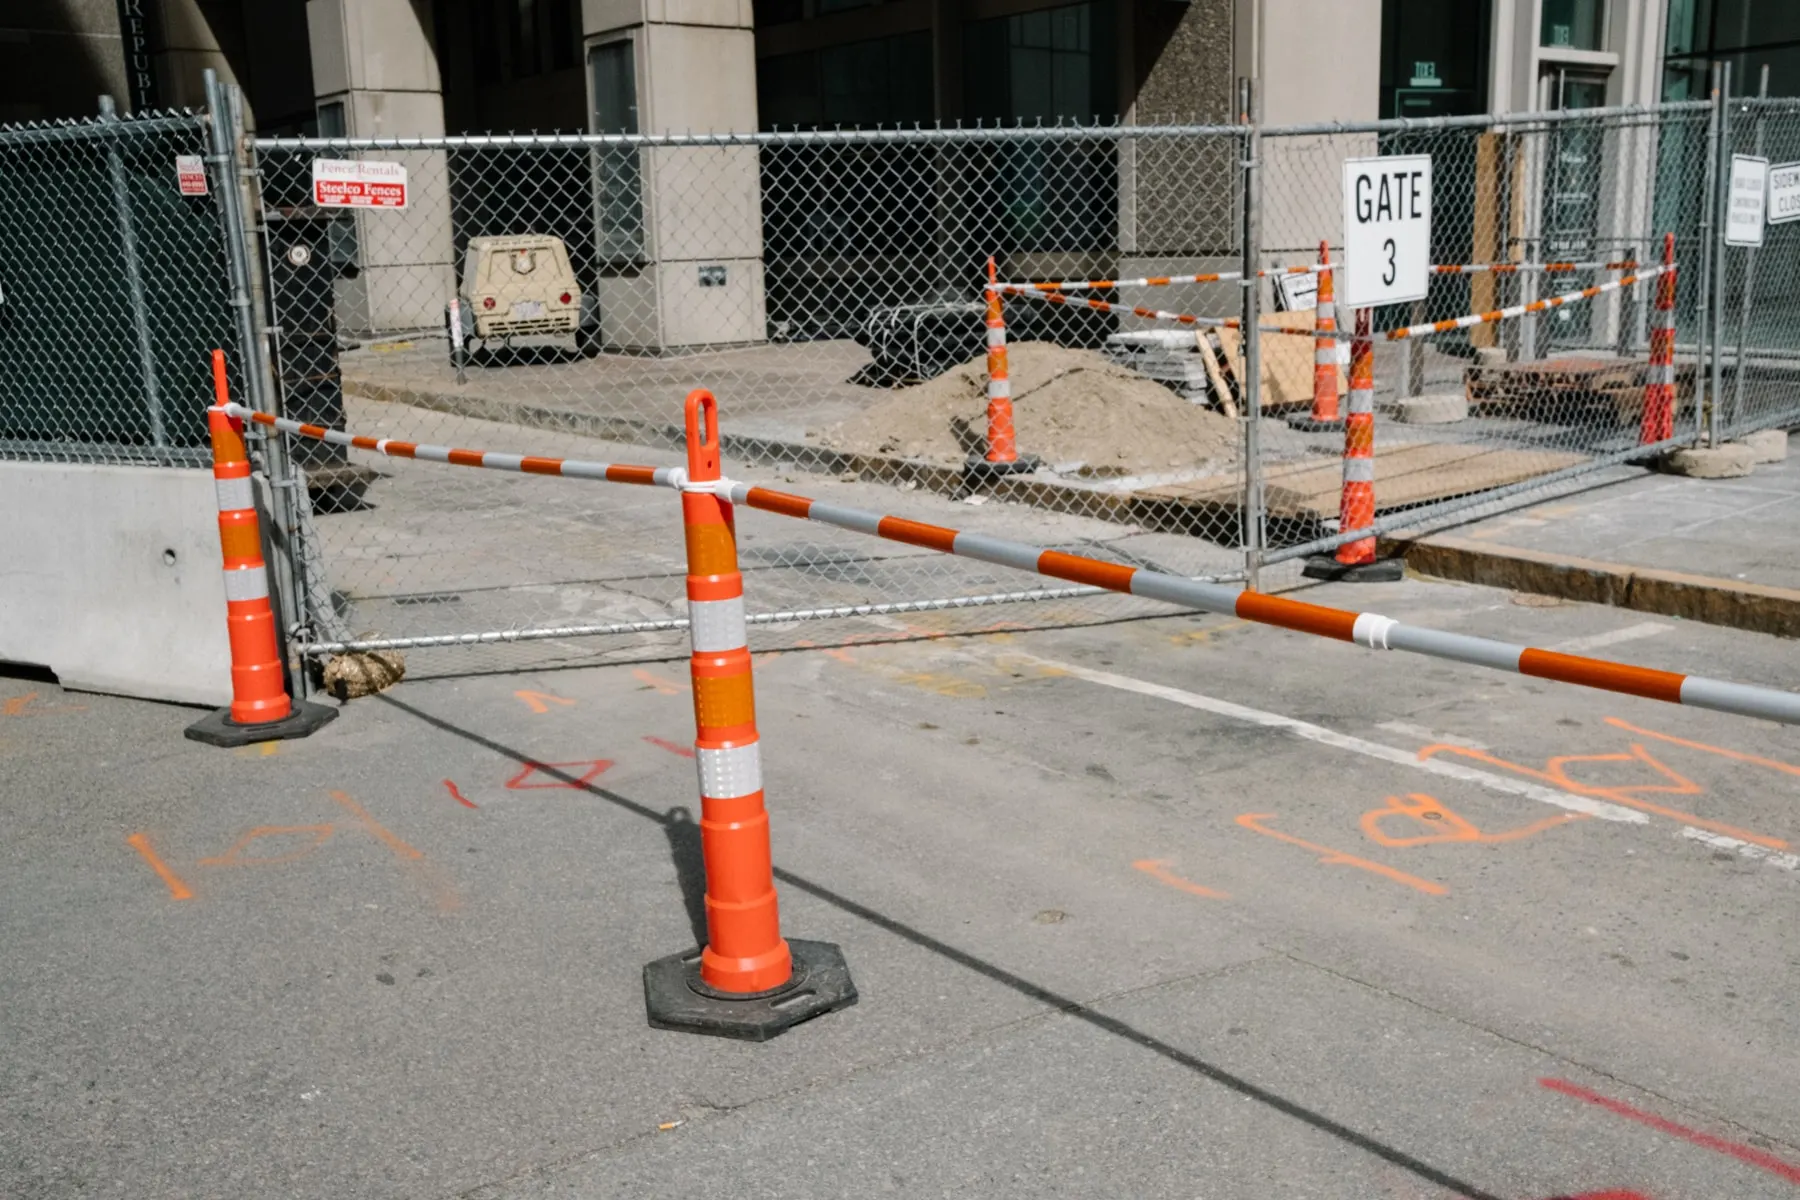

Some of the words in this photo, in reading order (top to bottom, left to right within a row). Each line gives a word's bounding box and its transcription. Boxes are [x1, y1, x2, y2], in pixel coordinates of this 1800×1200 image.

[321, 162, 353, 174] Fence
[357, 164, 399, 176] Rentals
[319, 181, 361, 195] Steelco
[364, 183, 402, 196] Fences
[1356, 172, 1422, 224] GATE
[1382, 238, 1397, 286] 3
